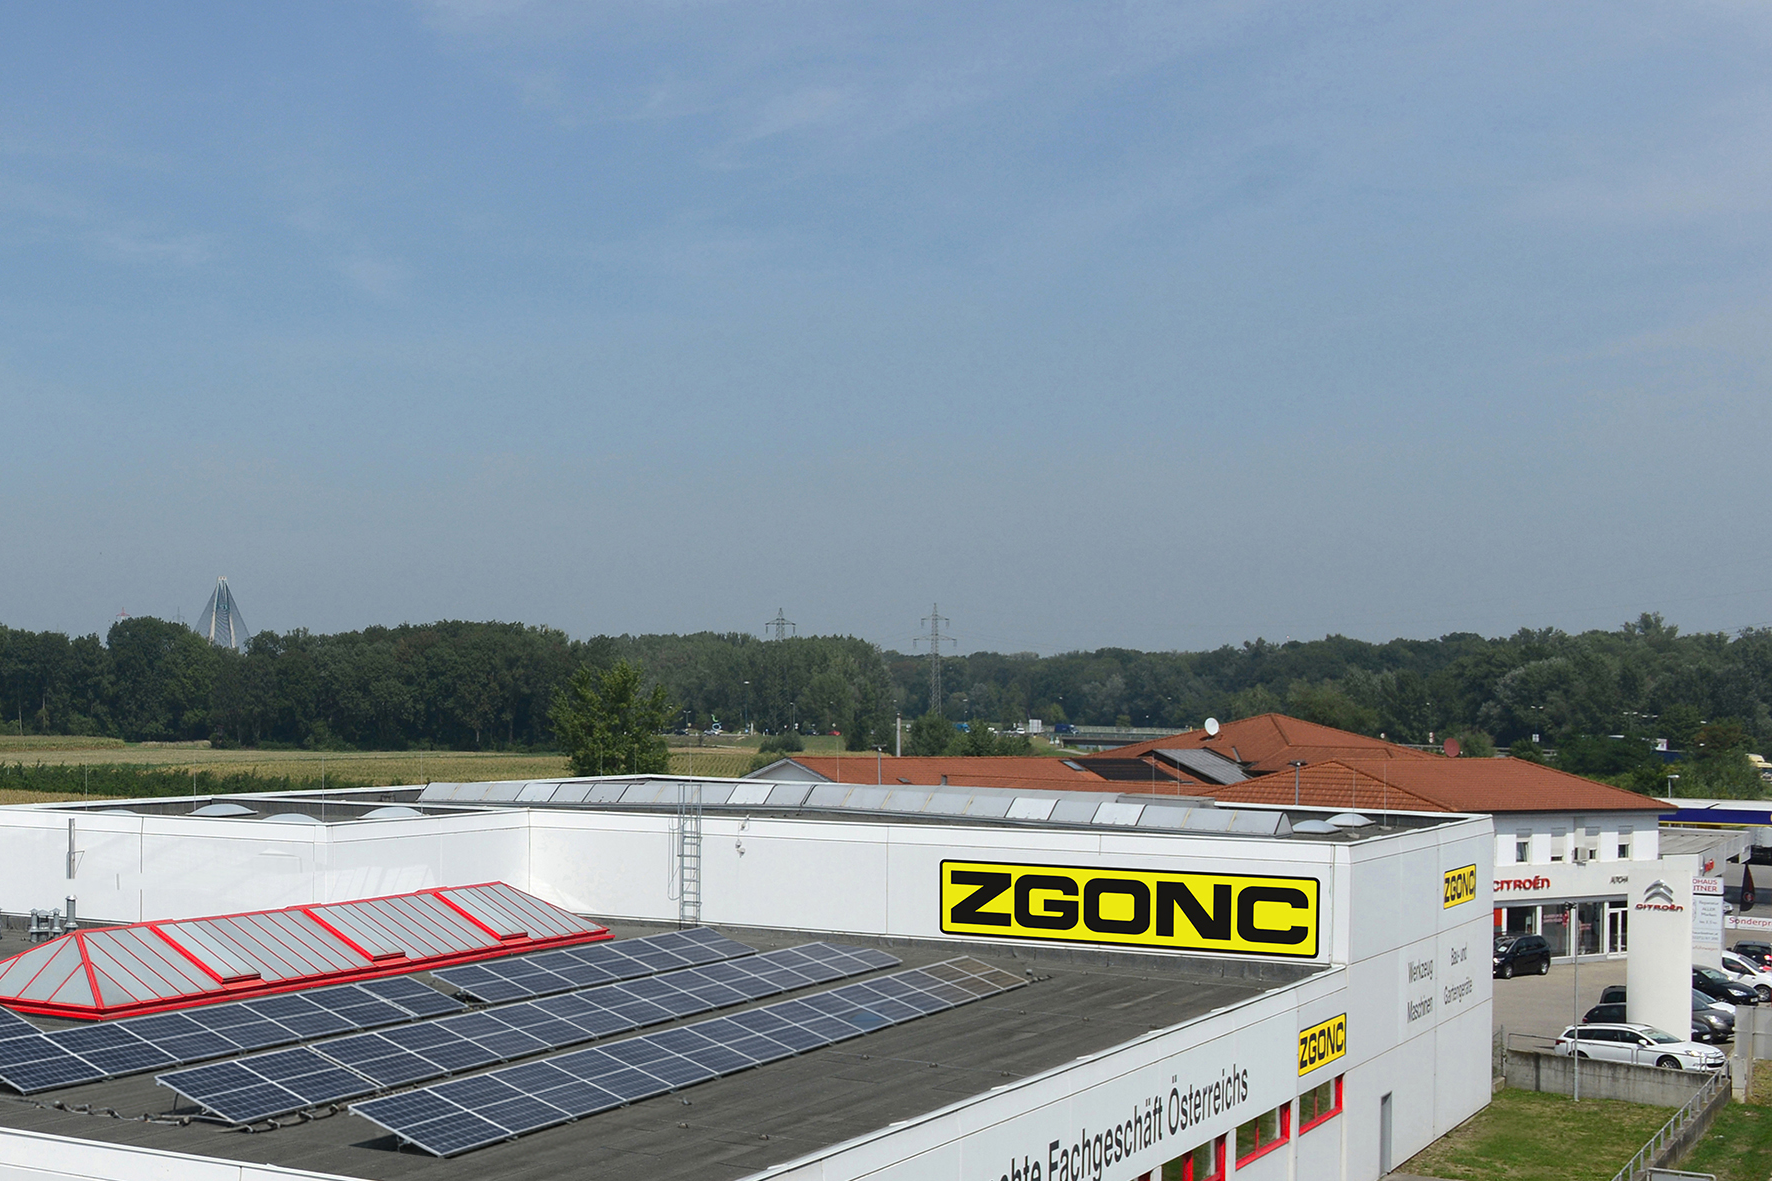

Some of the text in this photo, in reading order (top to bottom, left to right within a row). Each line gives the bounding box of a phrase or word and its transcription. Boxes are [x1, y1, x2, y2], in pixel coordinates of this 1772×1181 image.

[1444, 870, 1475, 903] ZGONC
[951, 871, 1309, 945] ZGONC
[1407, 959, 1434, 983] Werkzeug
[1443, 976, 1473, 1005] Gartengeräte
[1407, 994, 1434, 1024] Maschinen
[1299, 1021, 1344, 1069] ZGONC
[1168, 1063, 1249, 1136] Österreichs
